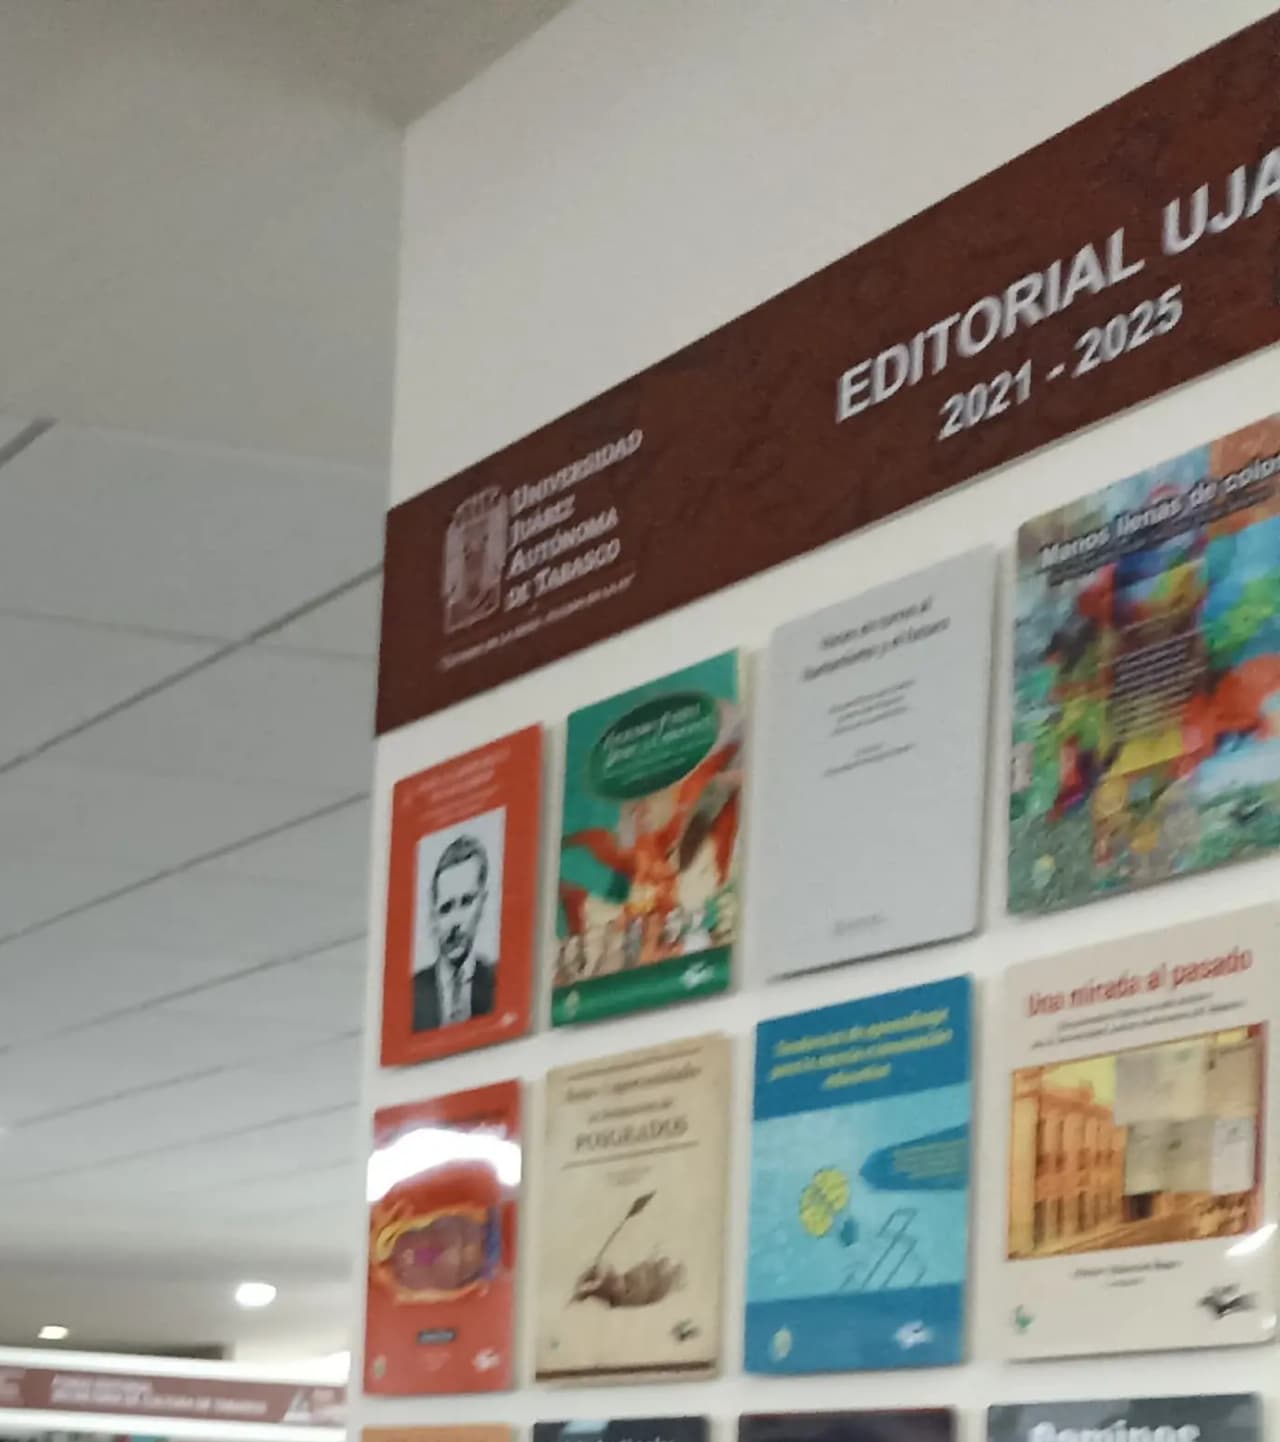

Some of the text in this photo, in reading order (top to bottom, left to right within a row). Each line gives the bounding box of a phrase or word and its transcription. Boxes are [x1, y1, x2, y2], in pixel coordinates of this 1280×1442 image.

[836, 228, 1145, 423] EDITORIAL
[938, 284, 1184, 440] 2021 - 2025
[1190, 480, 1217, 506] de
[1069, 969, 1140, 1009] mirada
[1146, 962, 1167, 992] al
[1171, 942, 1254, 991] pasado
